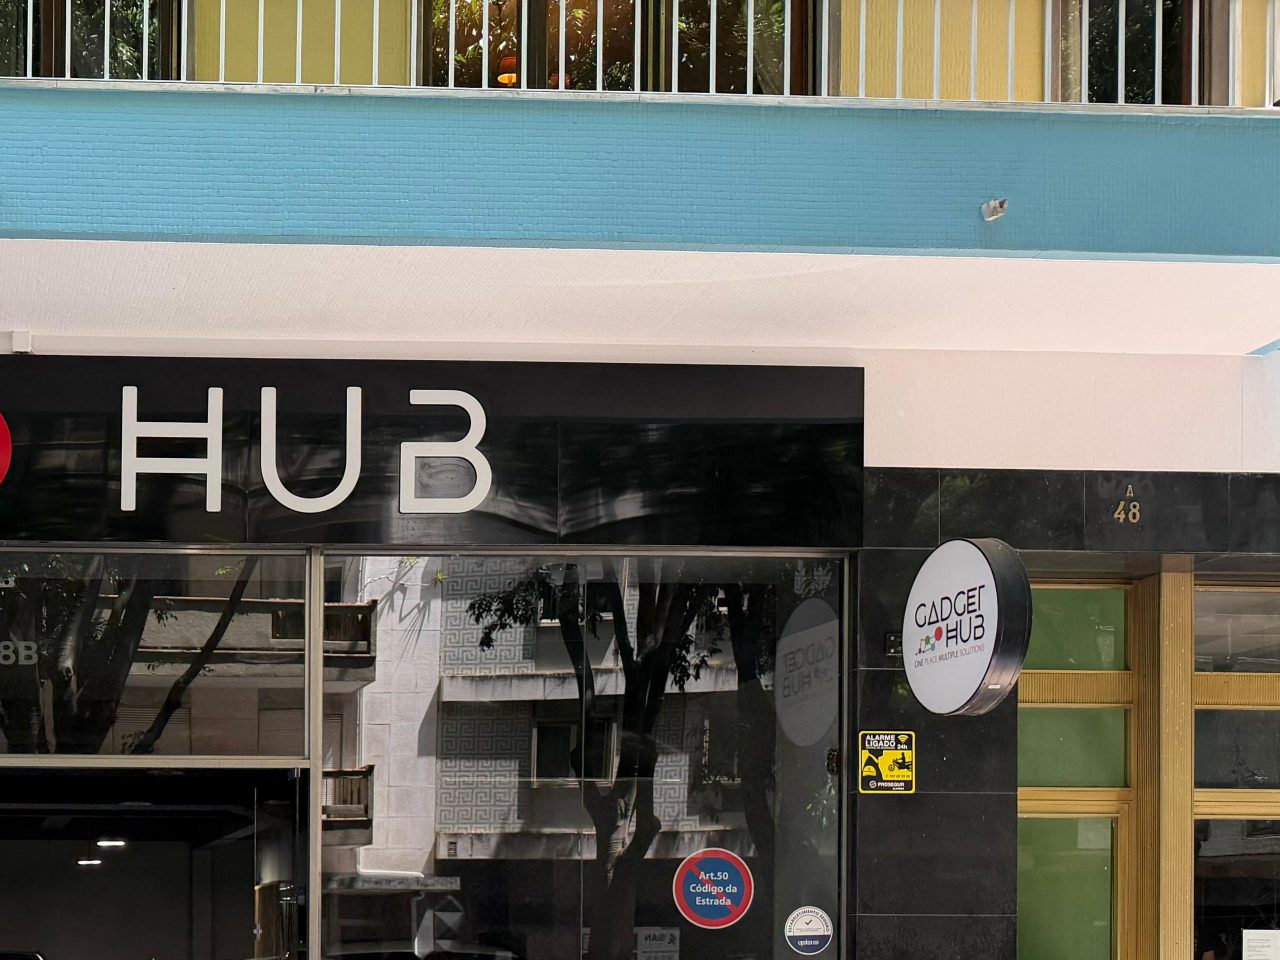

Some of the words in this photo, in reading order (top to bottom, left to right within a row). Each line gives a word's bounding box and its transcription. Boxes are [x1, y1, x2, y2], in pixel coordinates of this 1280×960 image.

[120, 385, 494, 515] HUB
[1126, 484, 1134, 497] A
[1113, 501, 1140, 523] 48
[914, 585, 985, 628] GADGET
[946, 614, 985, 648] HUB
[914, 660, 924, 668] ONE
[924, 656, 938, 664] PLACE
[938, 650, 959, 662] MULTIPLE
[960, 644, 984, 656] SOLUTIONS
[699, 872, 728, 880] Art.50
[690, 884, 723, 894] Código
[726, 884, 737, 892] da
[696, 897, 731, 905] Estrada
